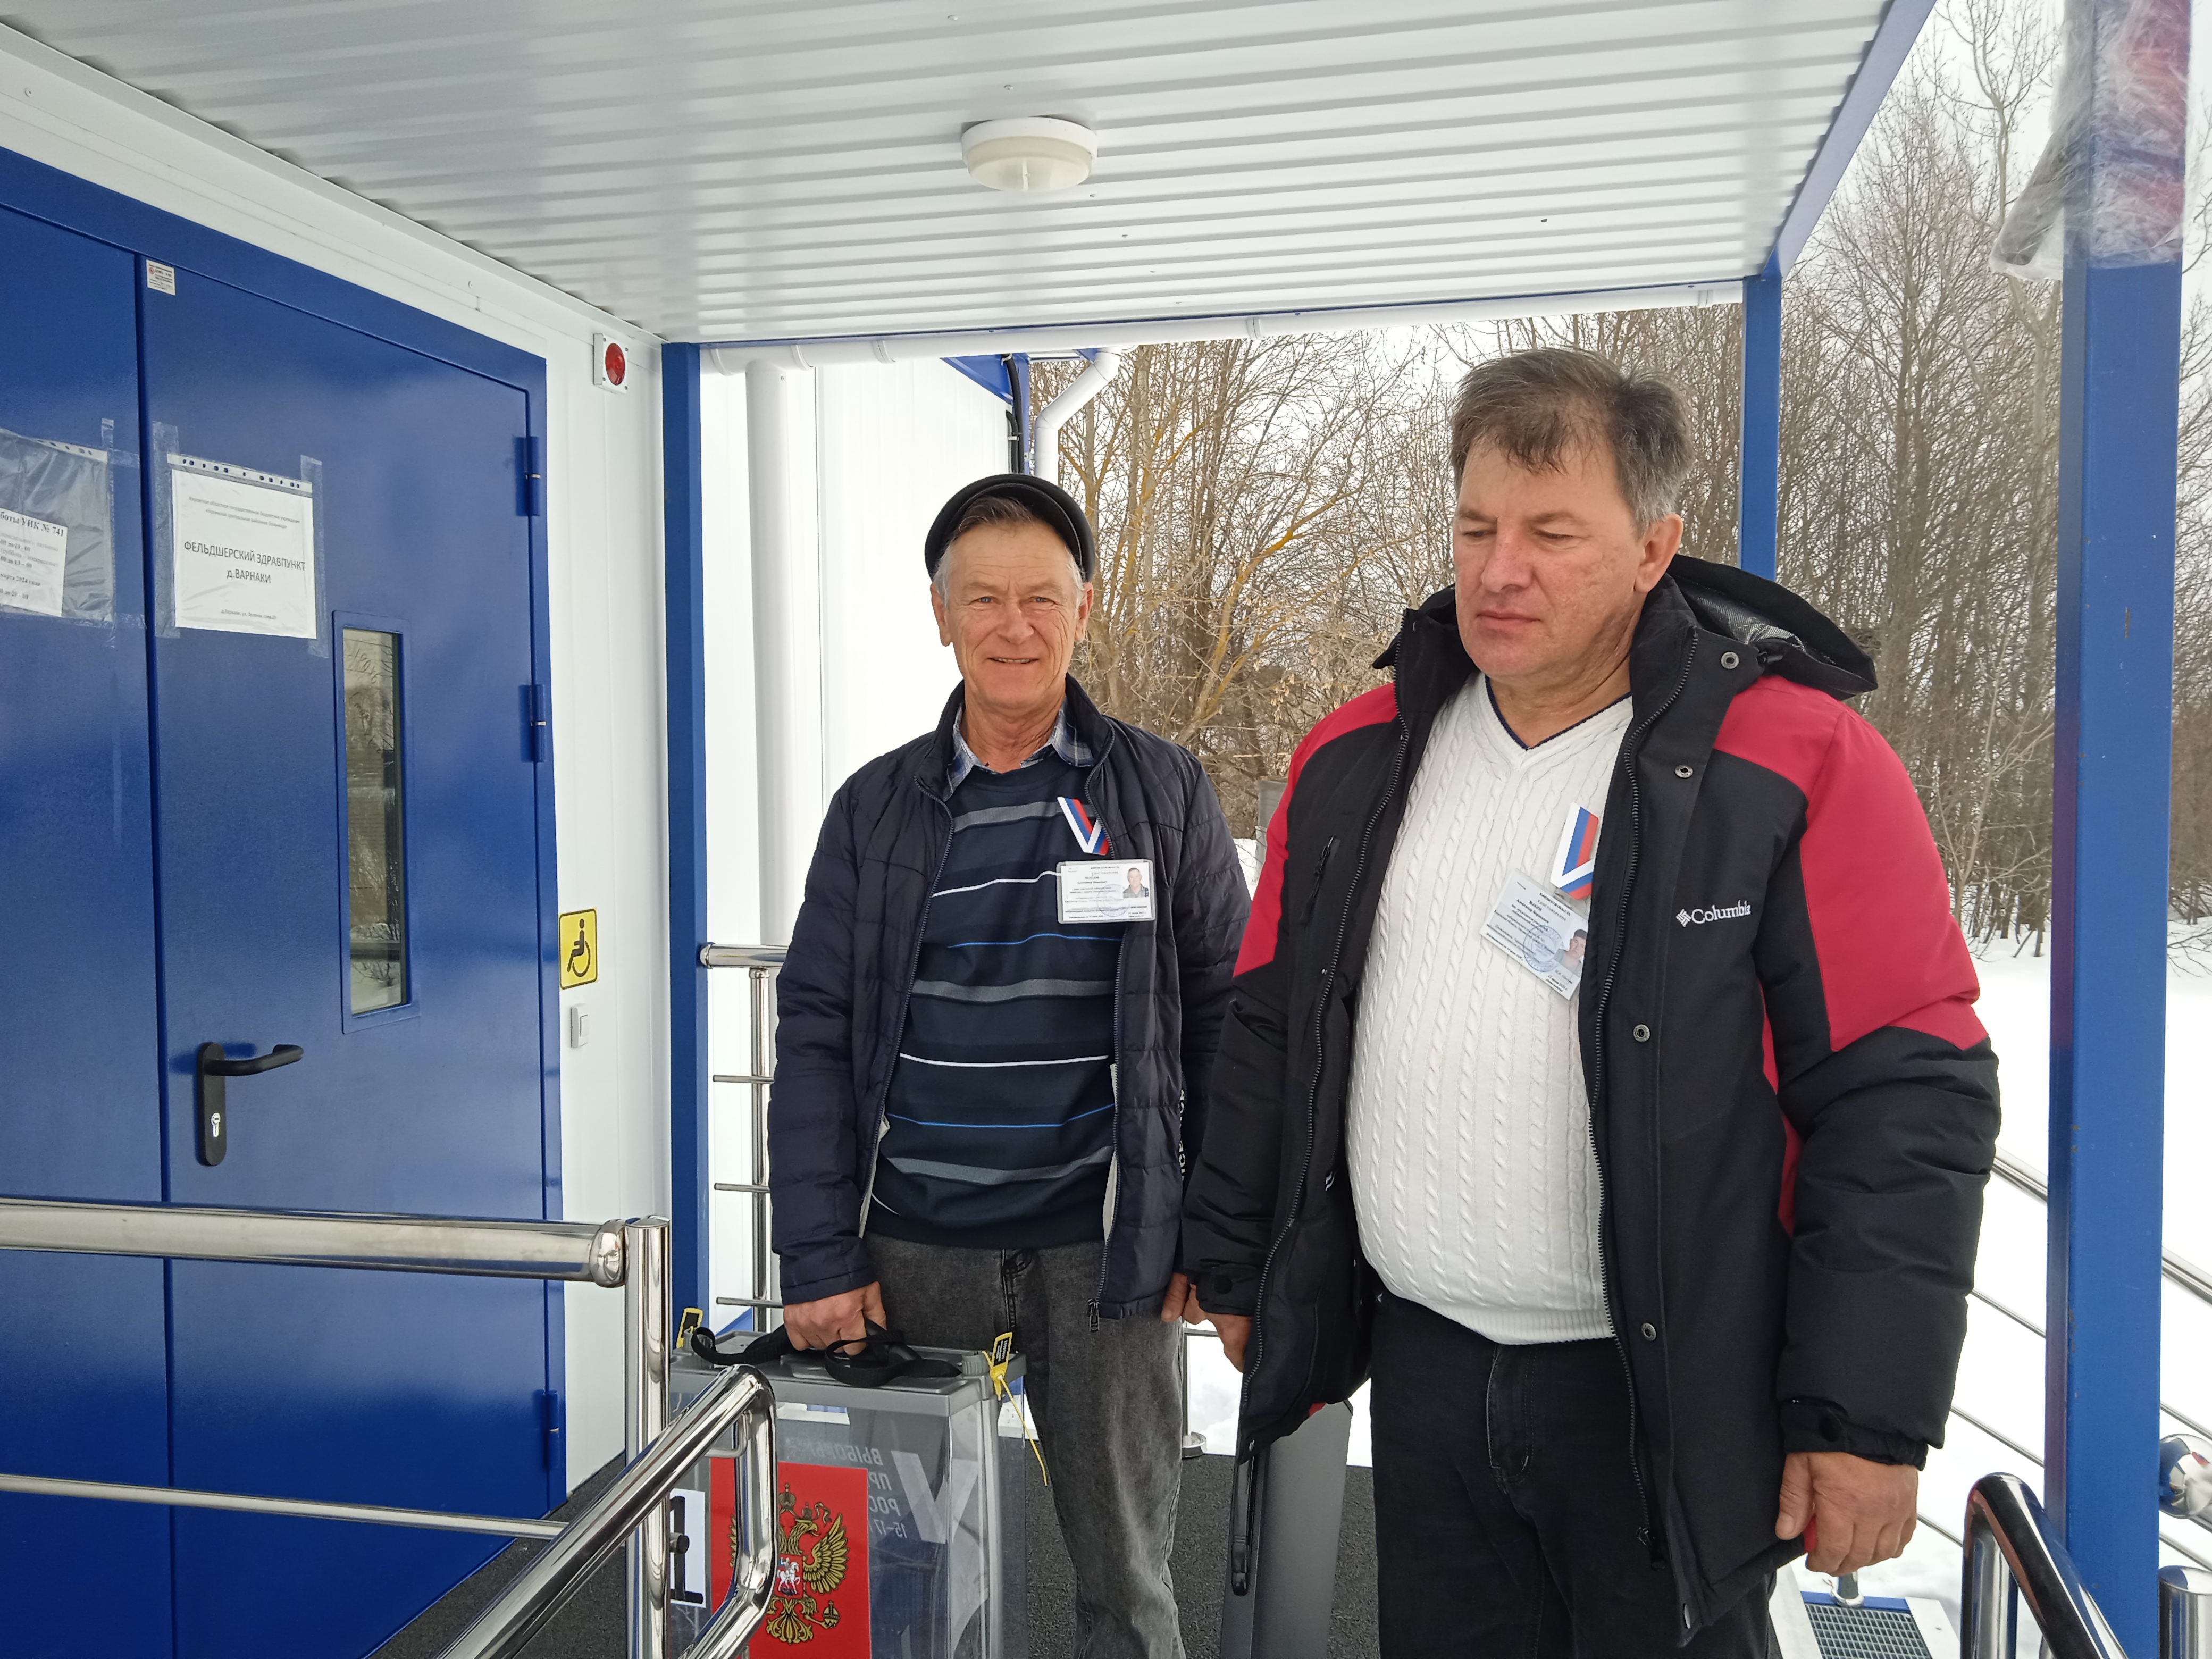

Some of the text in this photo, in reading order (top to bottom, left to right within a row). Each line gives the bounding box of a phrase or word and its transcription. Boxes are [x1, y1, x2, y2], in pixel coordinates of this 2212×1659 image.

[22, 517, 39, 530] УИК
[52, 526, 64, 537] 741
[184, 540, 306, 571] ФЕЛЬДШЕРСКИЙ ЗДРАВПУНКТ
[227, 569, 272, 584] д.ВАРНАКИ
